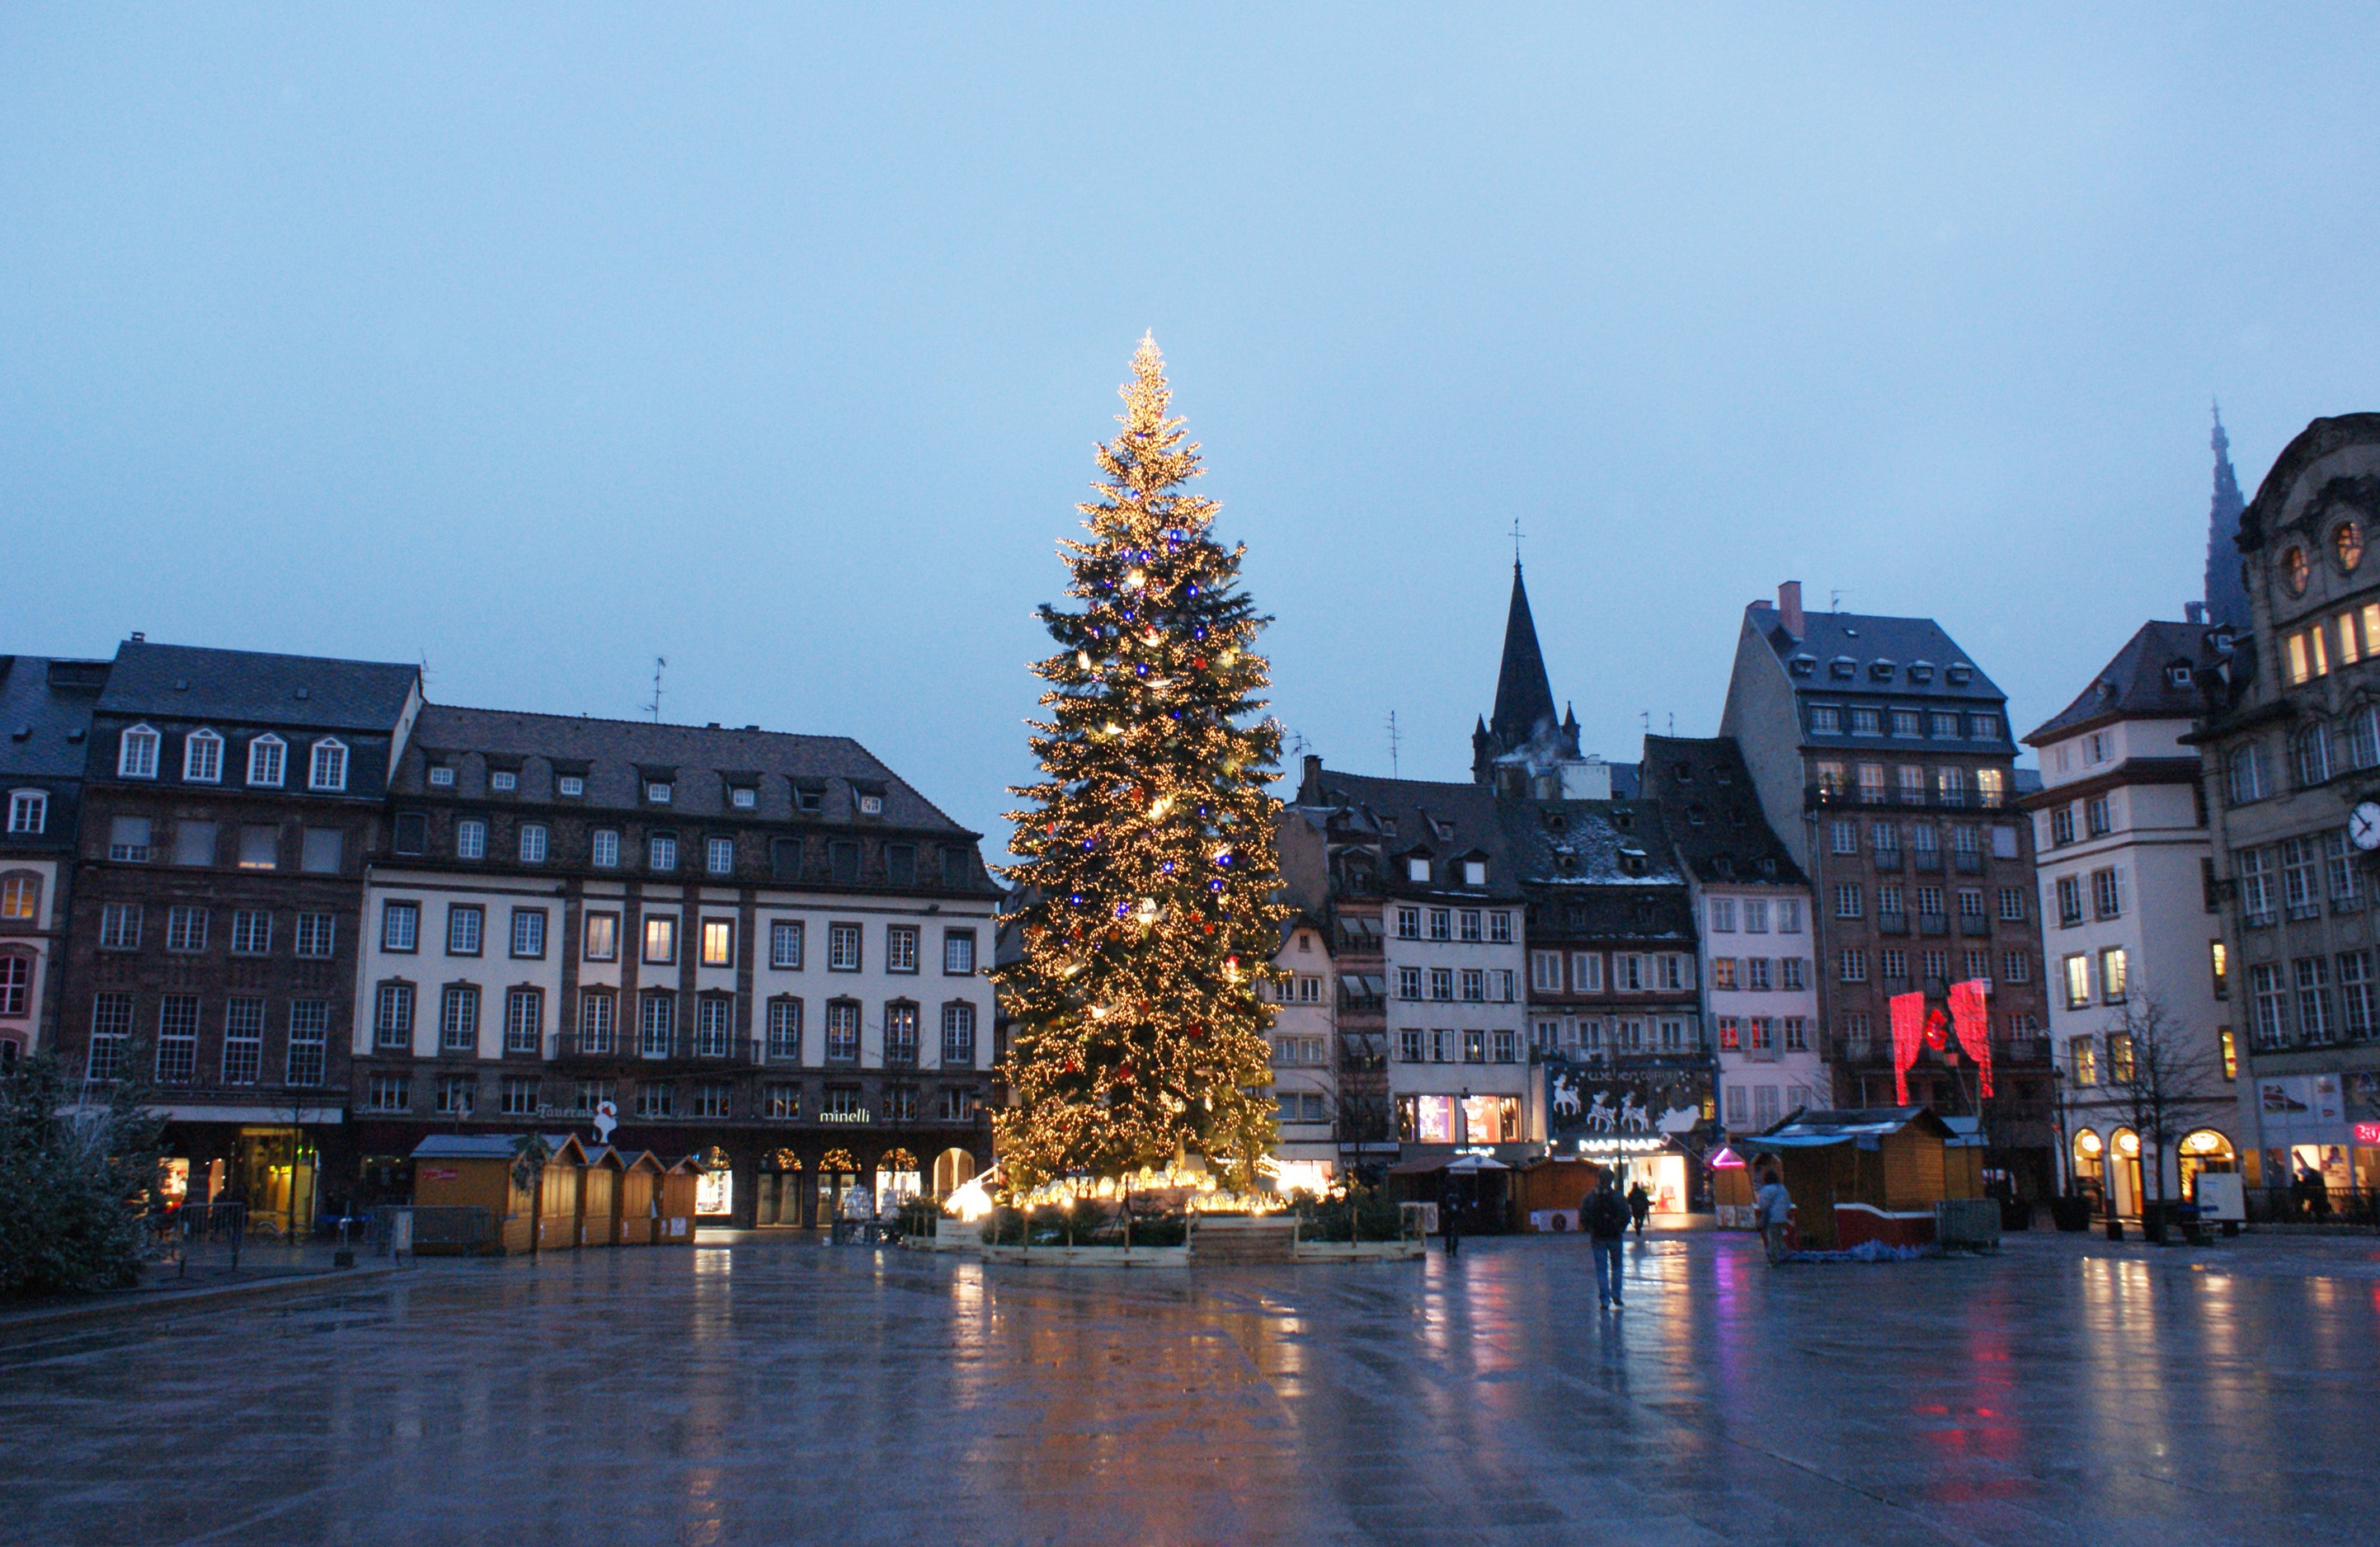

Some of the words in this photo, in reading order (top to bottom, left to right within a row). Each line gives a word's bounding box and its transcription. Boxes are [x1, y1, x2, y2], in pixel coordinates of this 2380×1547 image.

[820, 1108, 870, 1122] minelli
[1578, 1139, 1619, 1151] NAF
[1620, 1139, 1661, 1150] NAF
